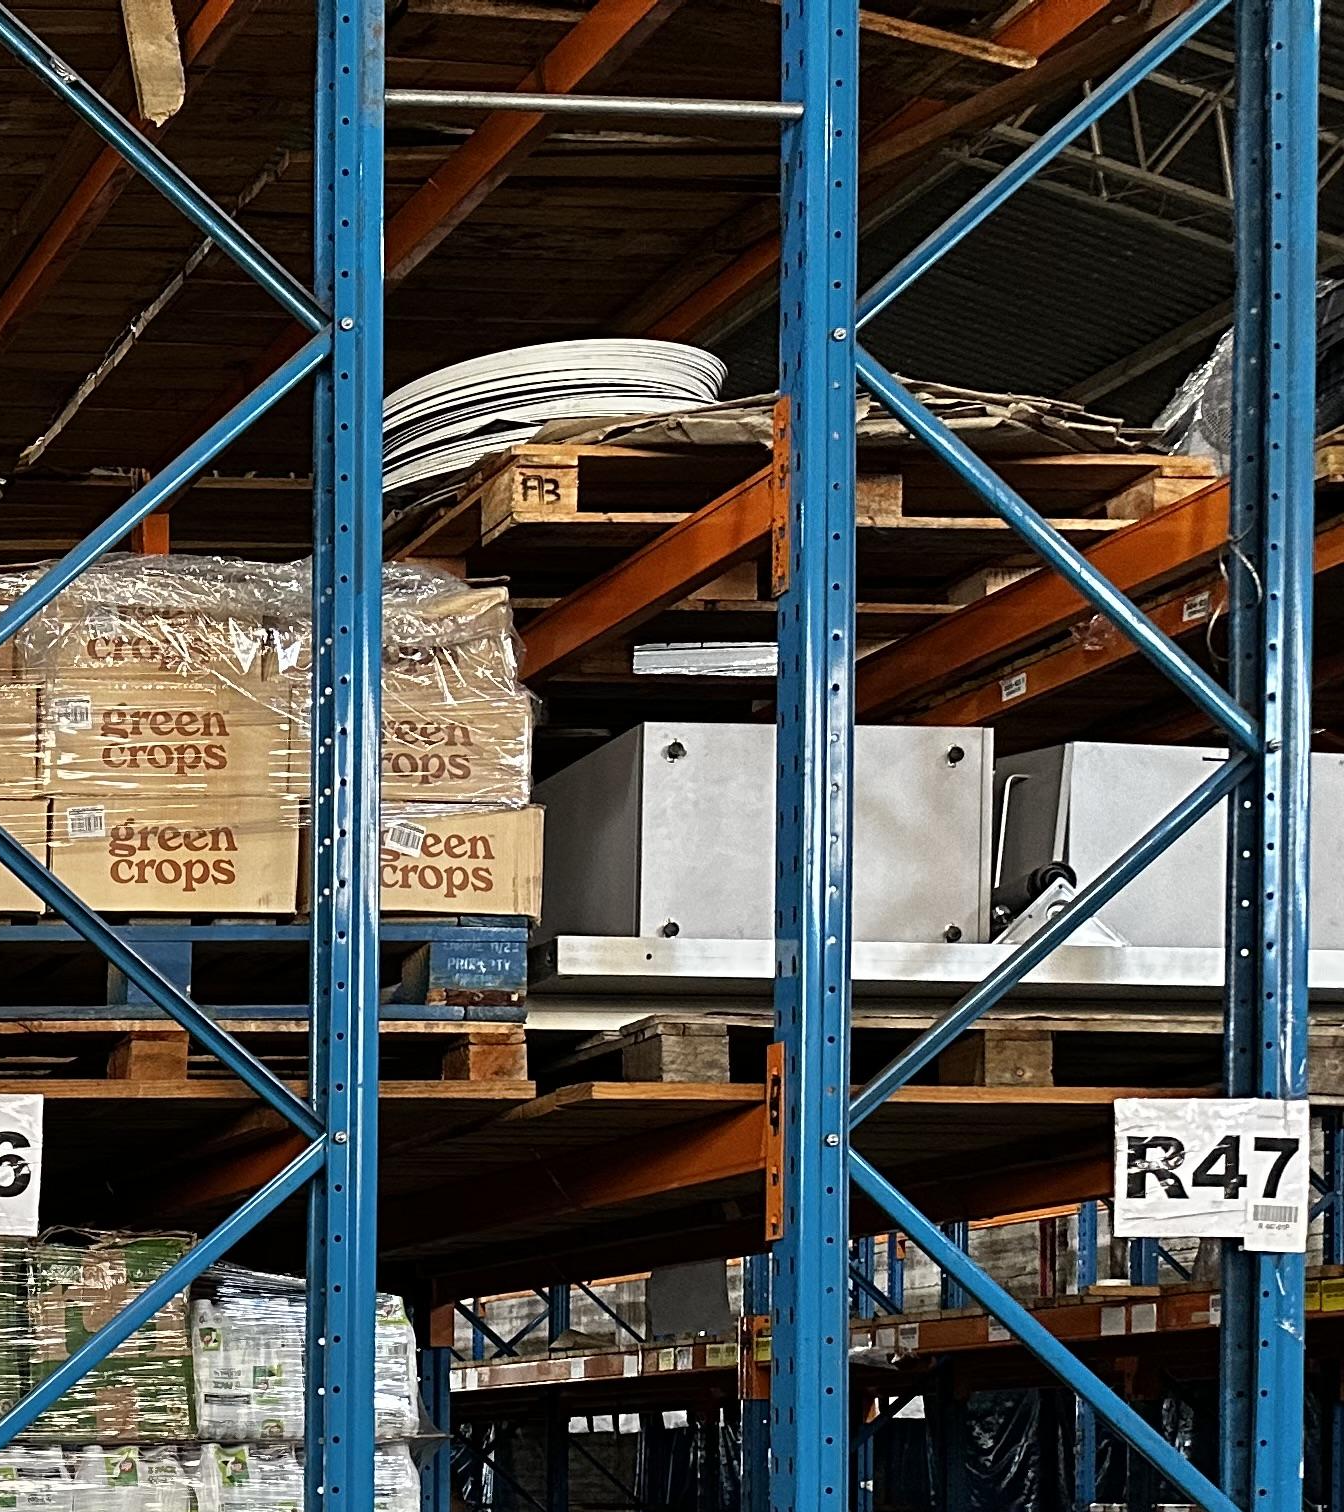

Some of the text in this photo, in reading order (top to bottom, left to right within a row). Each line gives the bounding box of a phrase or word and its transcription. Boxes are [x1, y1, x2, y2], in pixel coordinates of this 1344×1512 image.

[101, 704, 230, 739] green
[102, 743, 228, 775] crops
[109, 818, 238, 858] green
[110, 858, 237, 892] crops
[380, 865, 494, 898] crops
[1126, 1135, 1300, 1199] R47
